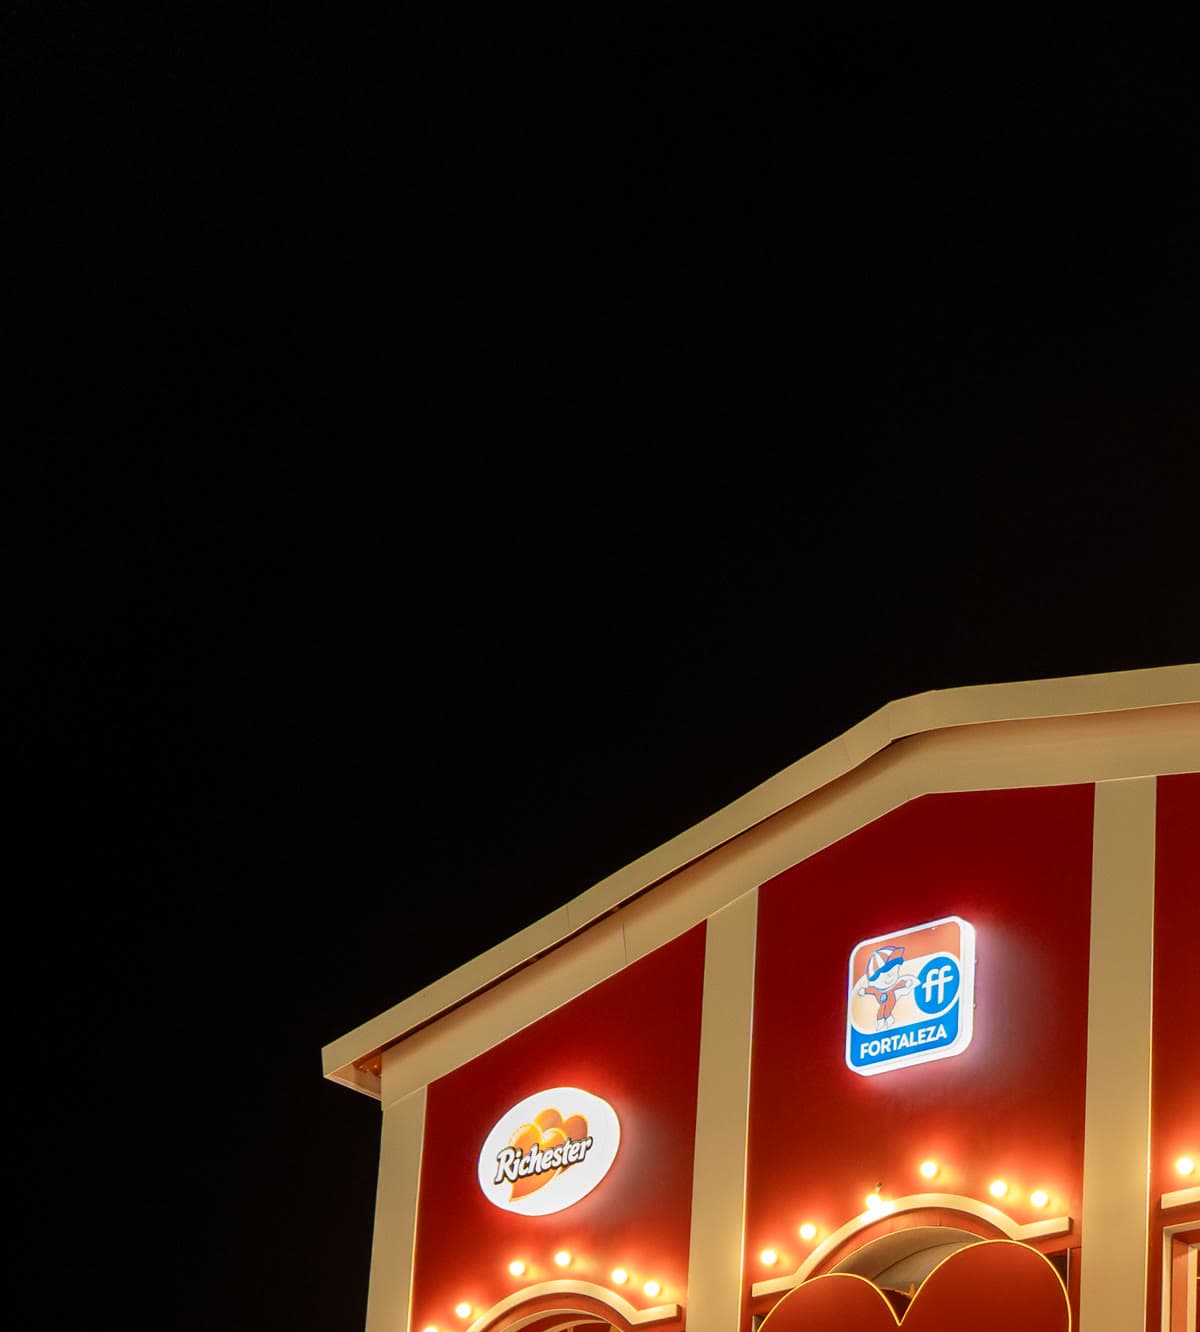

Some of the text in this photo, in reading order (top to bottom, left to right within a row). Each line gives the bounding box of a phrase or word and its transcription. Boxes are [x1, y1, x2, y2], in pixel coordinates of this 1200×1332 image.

[922, 965, 954, 1005] ff
[859, 1023, 947, 1060] FORTALEZA
[494, 1136, 594, 1186] Richester
